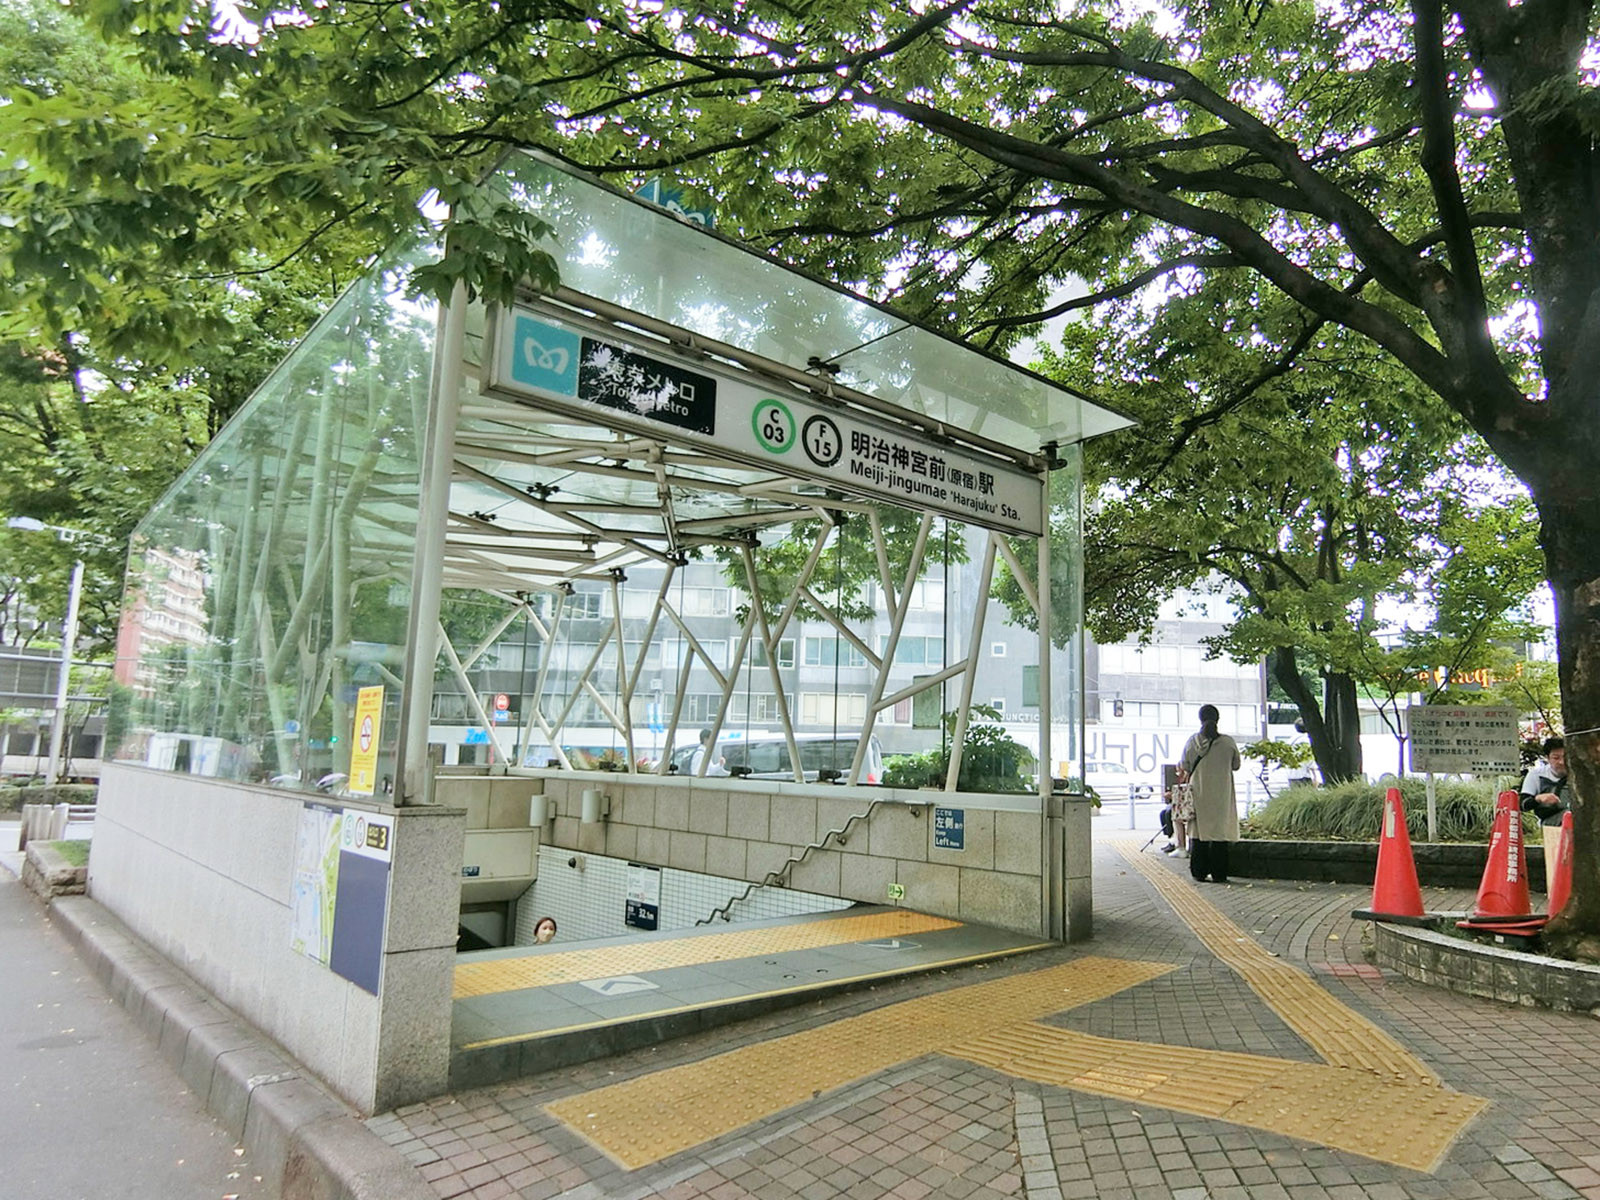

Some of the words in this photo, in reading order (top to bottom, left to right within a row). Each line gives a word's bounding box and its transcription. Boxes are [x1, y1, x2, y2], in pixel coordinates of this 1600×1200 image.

[770, 409, 780, 424] C
[763, 423, 785, 443] 03
[819, 424, 827, 438] F
[814, 439, 832, 457] 15
[850, 459, 947, 500] Meiji-jingumae
[1001, 503, 1021, 521] Sta.
[379, 826, 387, 848] 3
[935, 837, 949, 846] Left
